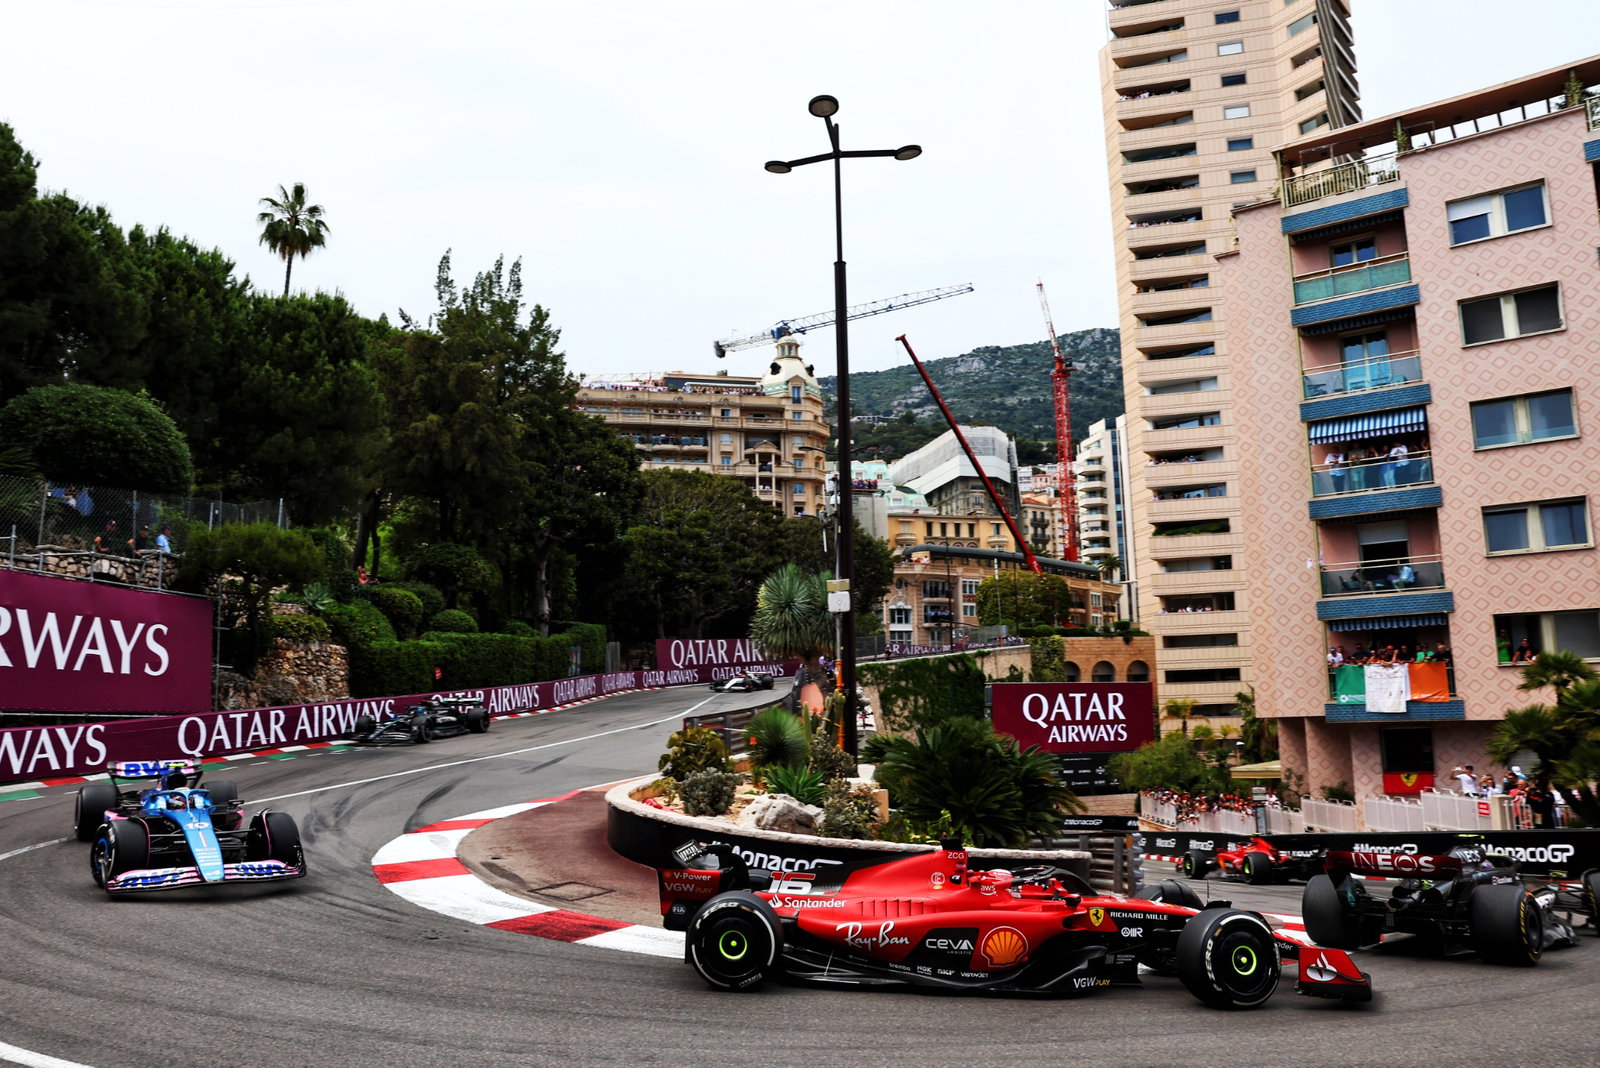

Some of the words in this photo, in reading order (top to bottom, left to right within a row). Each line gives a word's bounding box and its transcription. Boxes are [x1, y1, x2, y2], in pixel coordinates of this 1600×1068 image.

[671, 639, 729, 669] QATAR
[666, 668, 699, 685] AIRWAYS
[488, 685, 540, 714] AIRWAYS
[1022, 692, 1127, 729] QATAR
[177, 711, 287, 756] QATAR
[1048, 723, 1129, 743] AIRWAYS
[185, 821, 210, 829] 10
[1350, 852, 1436, 873] INEOS
[1474, 843, 1575, 863] MonacoGP
[674, 871, 712, 881] V-Power
[767, 871, 816, 895] 16
[784, 896, 847, 909] Santander
[1110, 911, 1144, 919] RICHARD
[1145, 913, 1169, 921] MILLE
[835, 920, 910, 952] Ray-Ban
[1073, 977, 1097, 989] VGW
